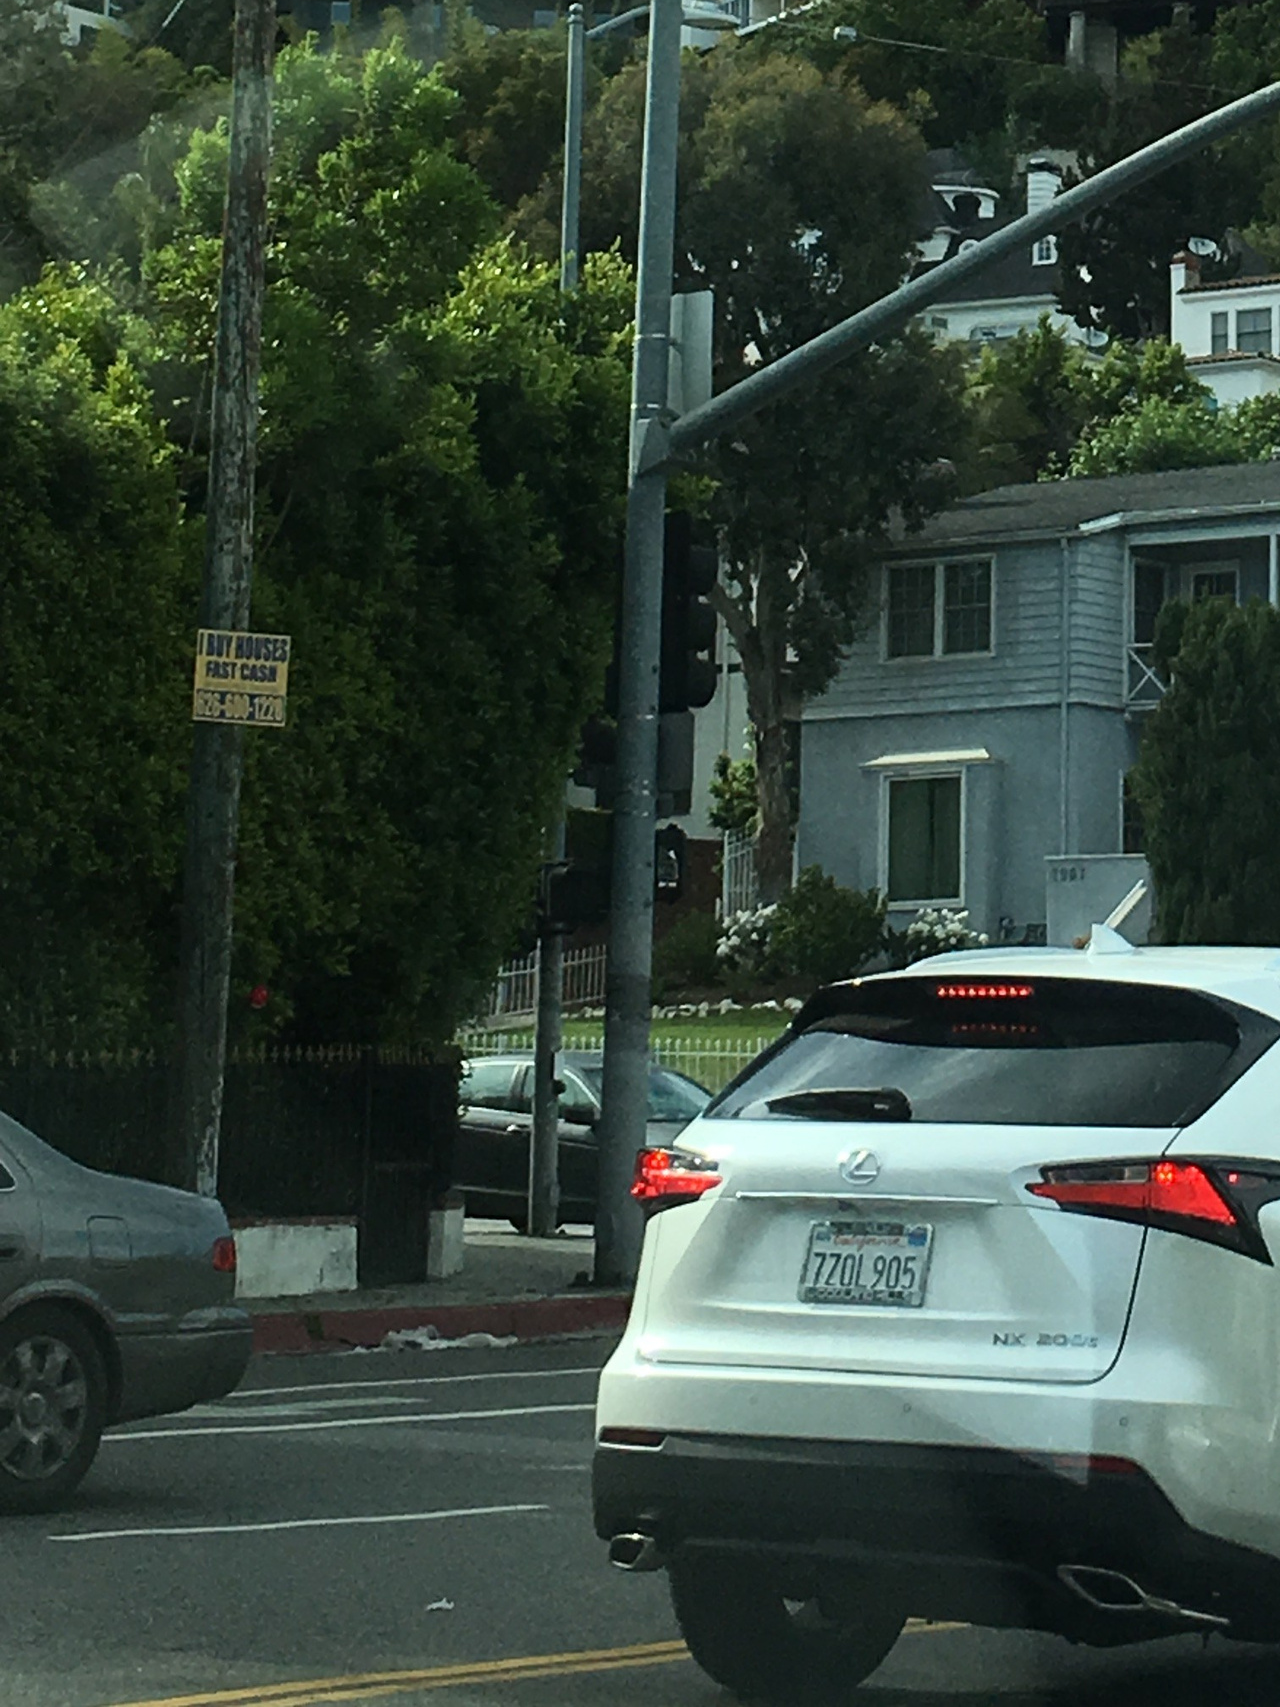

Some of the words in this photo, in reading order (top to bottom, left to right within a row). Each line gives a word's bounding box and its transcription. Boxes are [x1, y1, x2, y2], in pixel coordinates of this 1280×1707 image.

[198, 632, 204, 656] I
[206, 633, 233, 659] BUY
[235, 635, 288, 663] HOUSES
[206, 661, 238, 680] FAST
[240, 663, 277, 683] CASH
[992, 1333, 1026, 1347] NX
